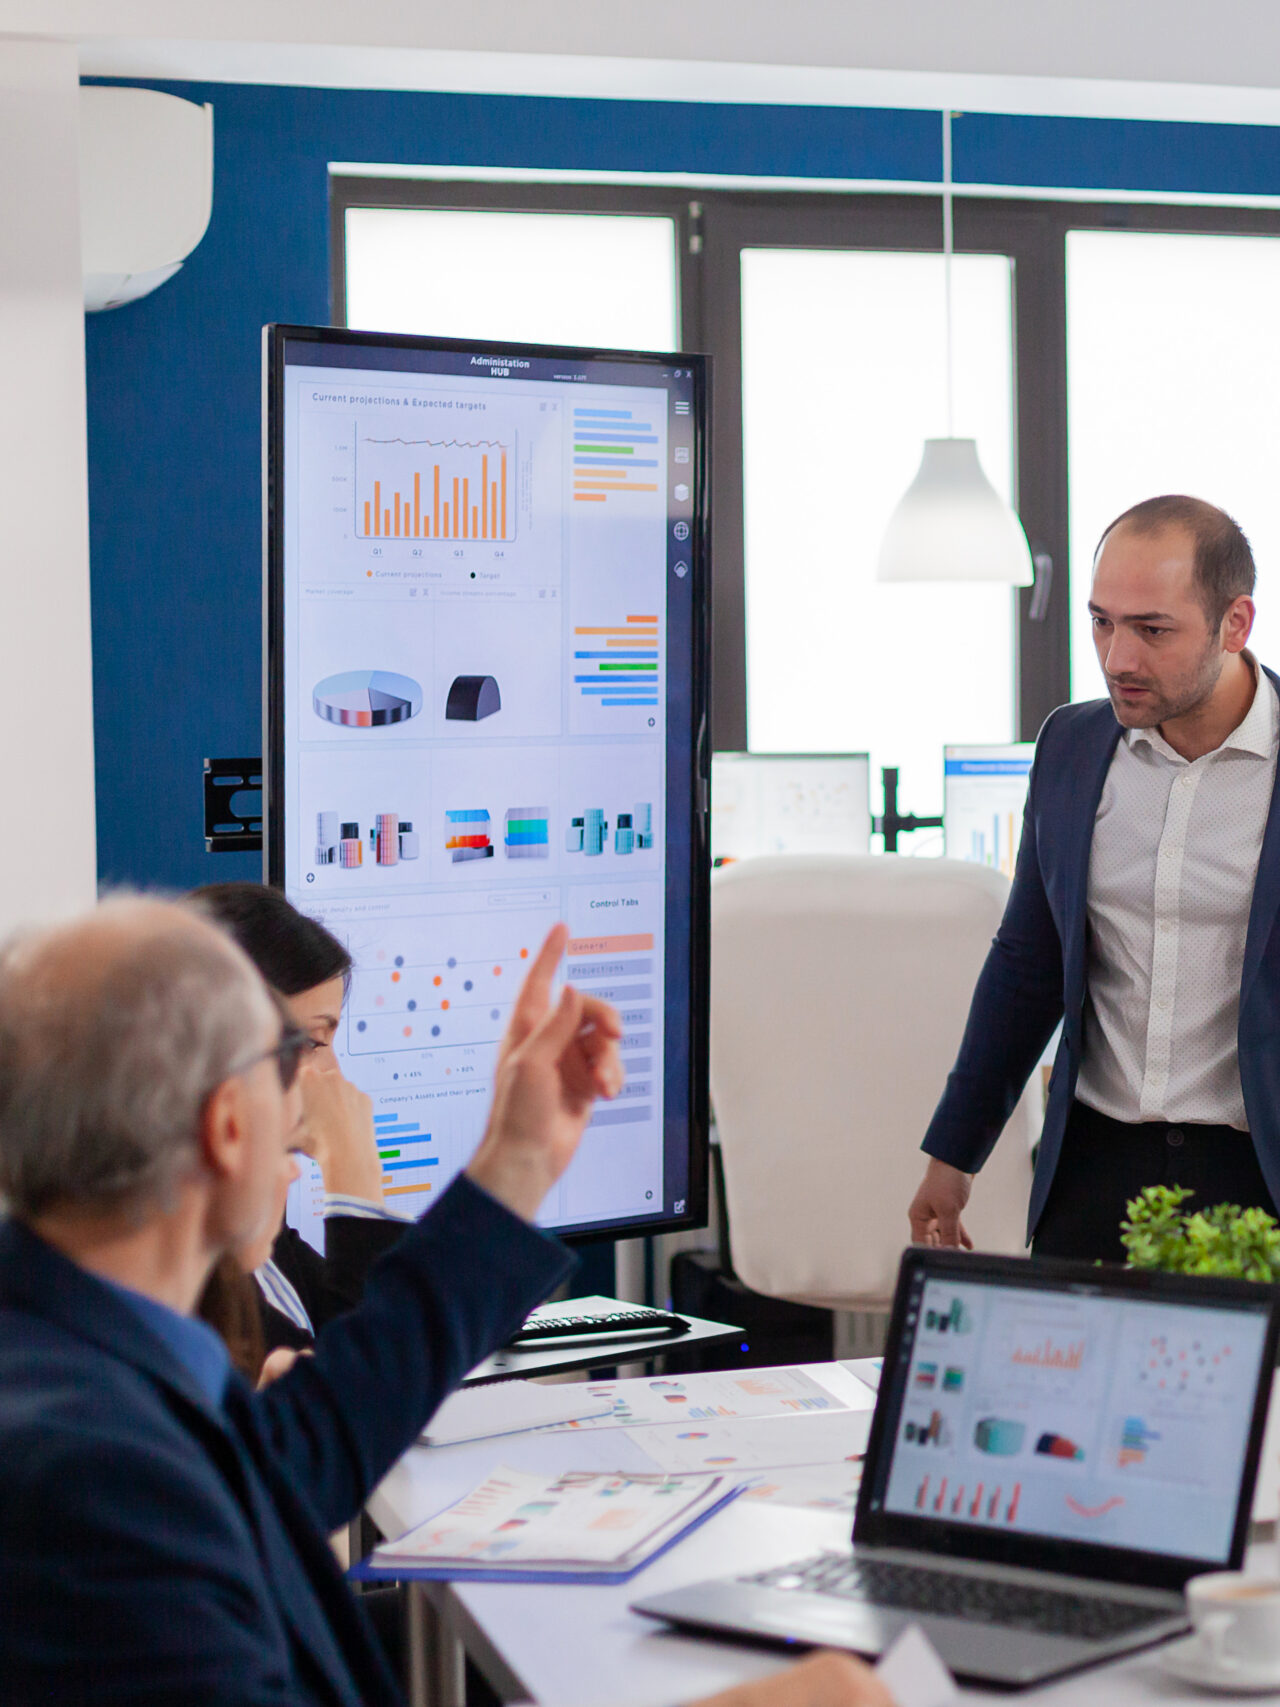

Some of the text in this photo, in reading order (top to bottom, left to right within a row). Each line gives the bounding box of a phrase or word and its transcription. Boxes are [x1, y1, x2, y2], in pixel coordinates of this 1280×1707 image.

[470, 356, 530, 369] Administation
[490, 367, 510, 376] HUB
[312, 392, 486, 411] Current projections & Expected targets
[372, 547, 382, 555] Q1
[412, 548, 422, 556] Q2
[453, 549, 463, 557] Q3
[494, 550, 504, 558] Q4
[375, 570, 442, 580] Current projections
[480, 571, 500, 580] Target
[589, 898, 639, 909] Control Tabs
[572, 941, 608, 951] General
[571, 964, 624, 975] Projections
[379, 1095, 413, 1104] Company's
[415, 1093, 435, 1101] Assets
[449, 1089, 464, 1097] their
